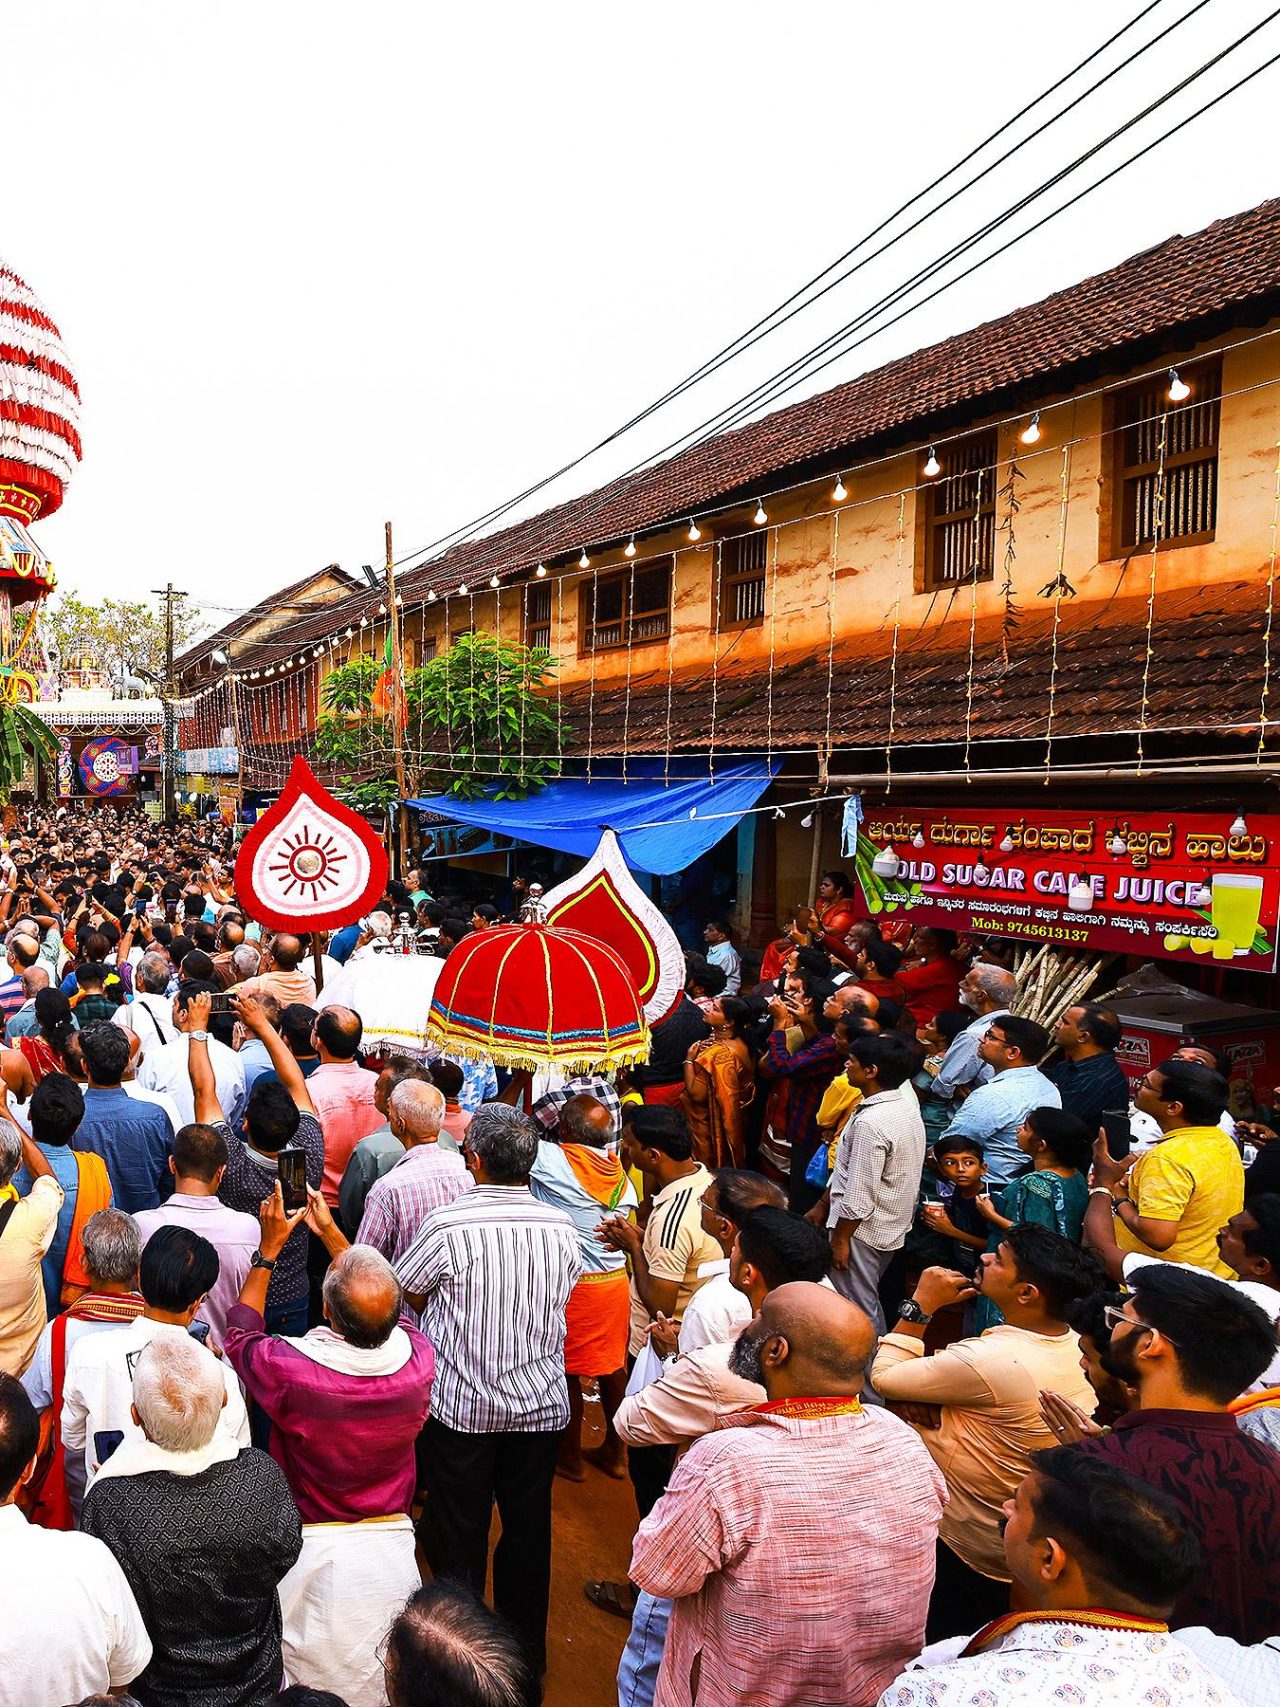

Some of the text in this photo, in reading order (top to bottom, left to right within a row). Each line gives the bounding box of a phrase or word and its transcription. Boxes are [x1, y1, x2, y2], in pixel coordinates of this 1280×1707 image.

[930, 816, 997, 846] ದುರ್ಗಾ
[1186, 832, 1266, 862] ಹಾಲು
[894, 861, 936, 881] OLD
[942, 862, 1025, 891] SUGAR
[1113, 877, 1205, 907] JUICE
[971, 917, 1089, 942] Mob: 9745613137
